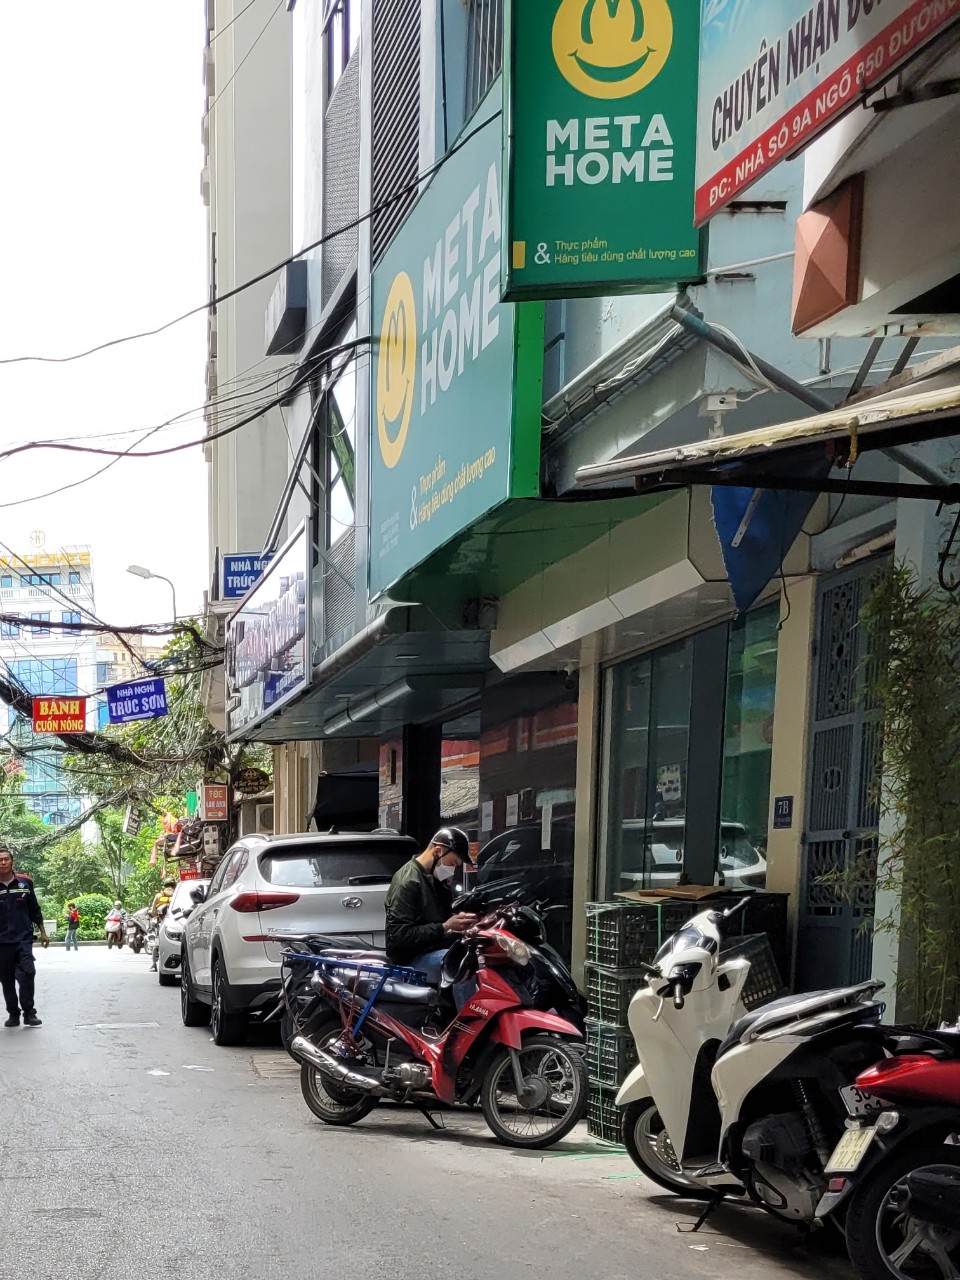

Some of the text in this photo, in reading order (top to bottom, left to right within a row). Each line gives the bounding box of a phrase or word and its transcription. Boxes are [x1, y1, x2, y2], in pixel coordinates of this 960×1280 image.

[712, 38, 781, 151] CHUYÊN
[546, 113, 674, 152] META
[708, 176, 732, 207] ĐC:
[768, 121, 790, 159] SỐ
[792, 114, 812, 139] 9A
[815, 69, 852, 120] NGÕ
[855, 51, 885, 86] 850
[545, 148, 674, 187] HOME
[422, 161, 501, 335] META
[678, 249, 696, 257] cao
[420, 249, 500, 416] HOME
[230, 558, 252, 572] NHÀ
[226, 573, 256, 588] TRÚC
[116, 681, 156, 699] NHÀ NGHỈ
[40, 700, 80, 715] BÁNH
[110, 693, 166, 716] TRÚC SƠN
[35, 716, 84, 732] CUỐN NÓNG
[778, 800, 789, 815] 7B
